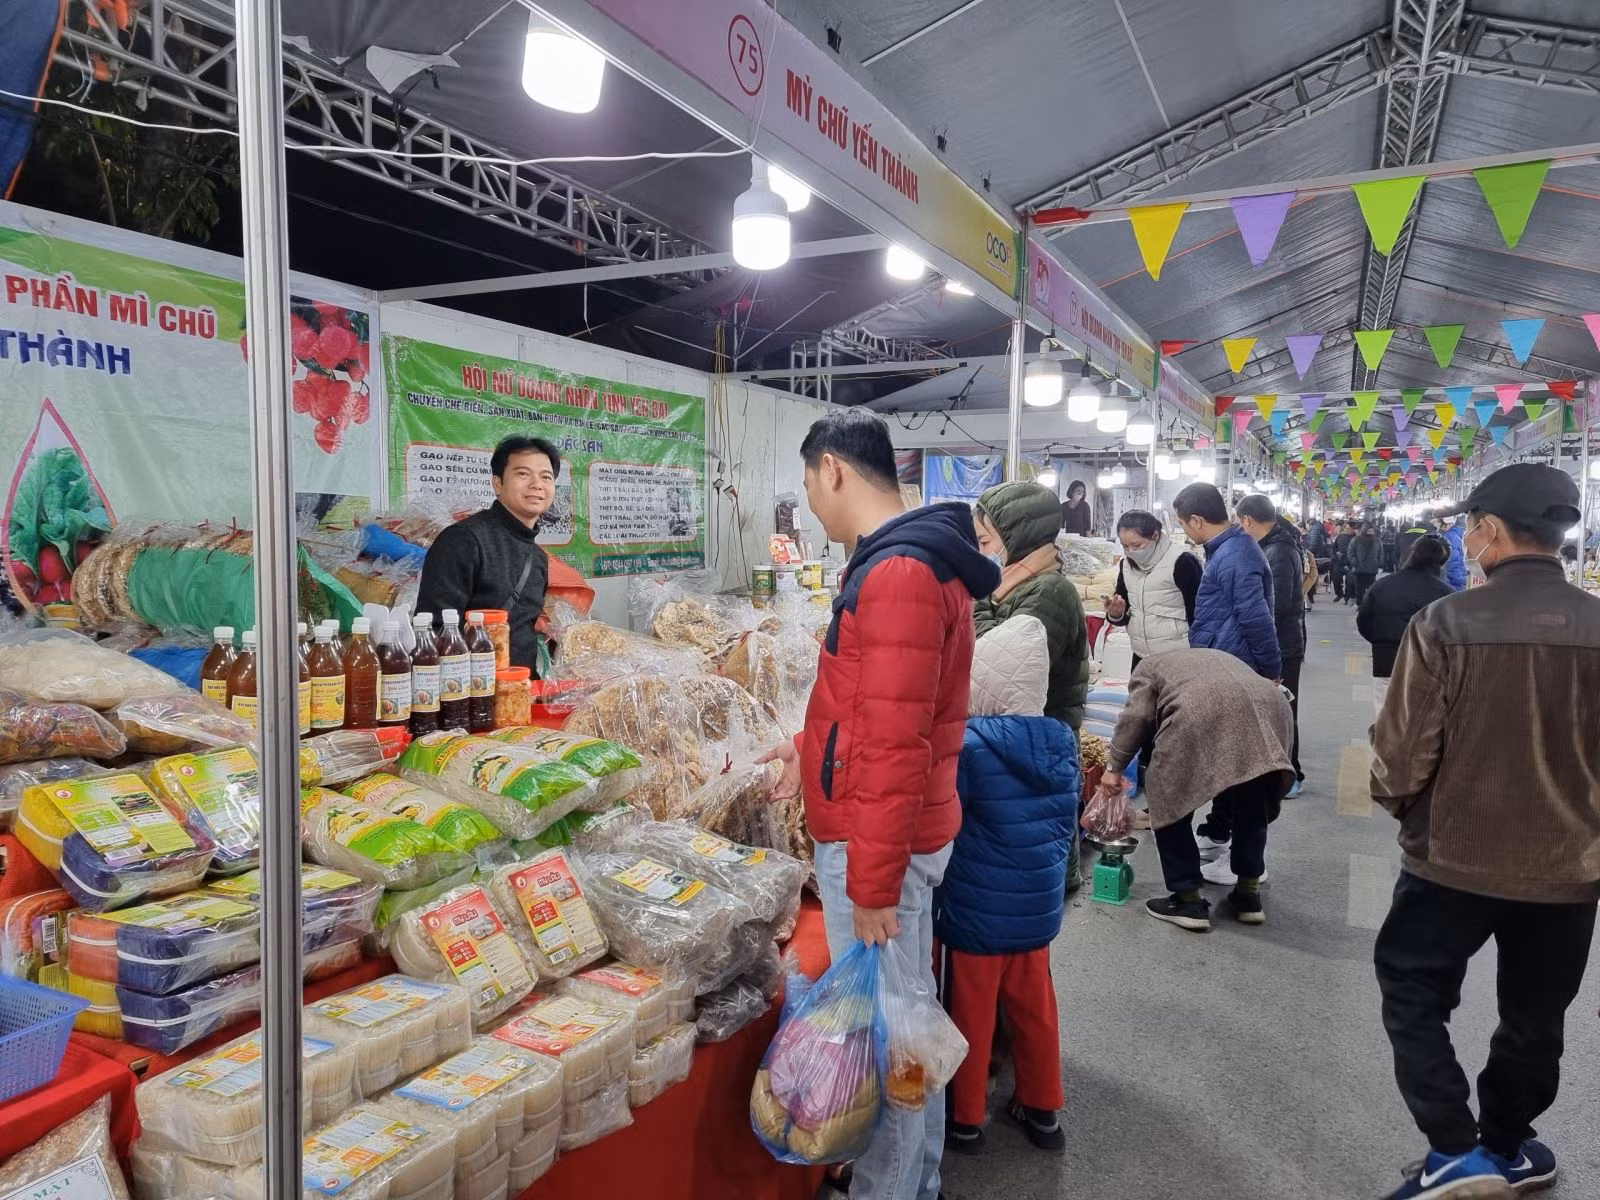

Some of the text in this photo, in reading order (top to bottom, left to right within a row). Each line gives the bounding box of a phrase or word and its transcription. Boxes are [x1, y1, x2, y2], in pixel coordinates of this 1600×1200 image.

[736, 33, 758, 74] 75
[817, 96, 849, 151] CHŨ
[852, 122, 878, 174] YẾN
[881, 146, 919, 205] THÀNH
[5, 275, 215, 339] PHẦN MÌ CHŨ
[0, 329, 131, 375] THÀNH
[407, 391, 442, 407] CHUYÊN
[461, 362, 488, 395] HỘI
[492, 367, 513, 397] NỮ
[517, 376, 562, 404] DOANH
[565, 383, 599, 410] NHÂN
[420, 451, 443, 461] GẠO
[420, 463, 443, 473] GẠO
[420, 475, 443, 485] GẠO
